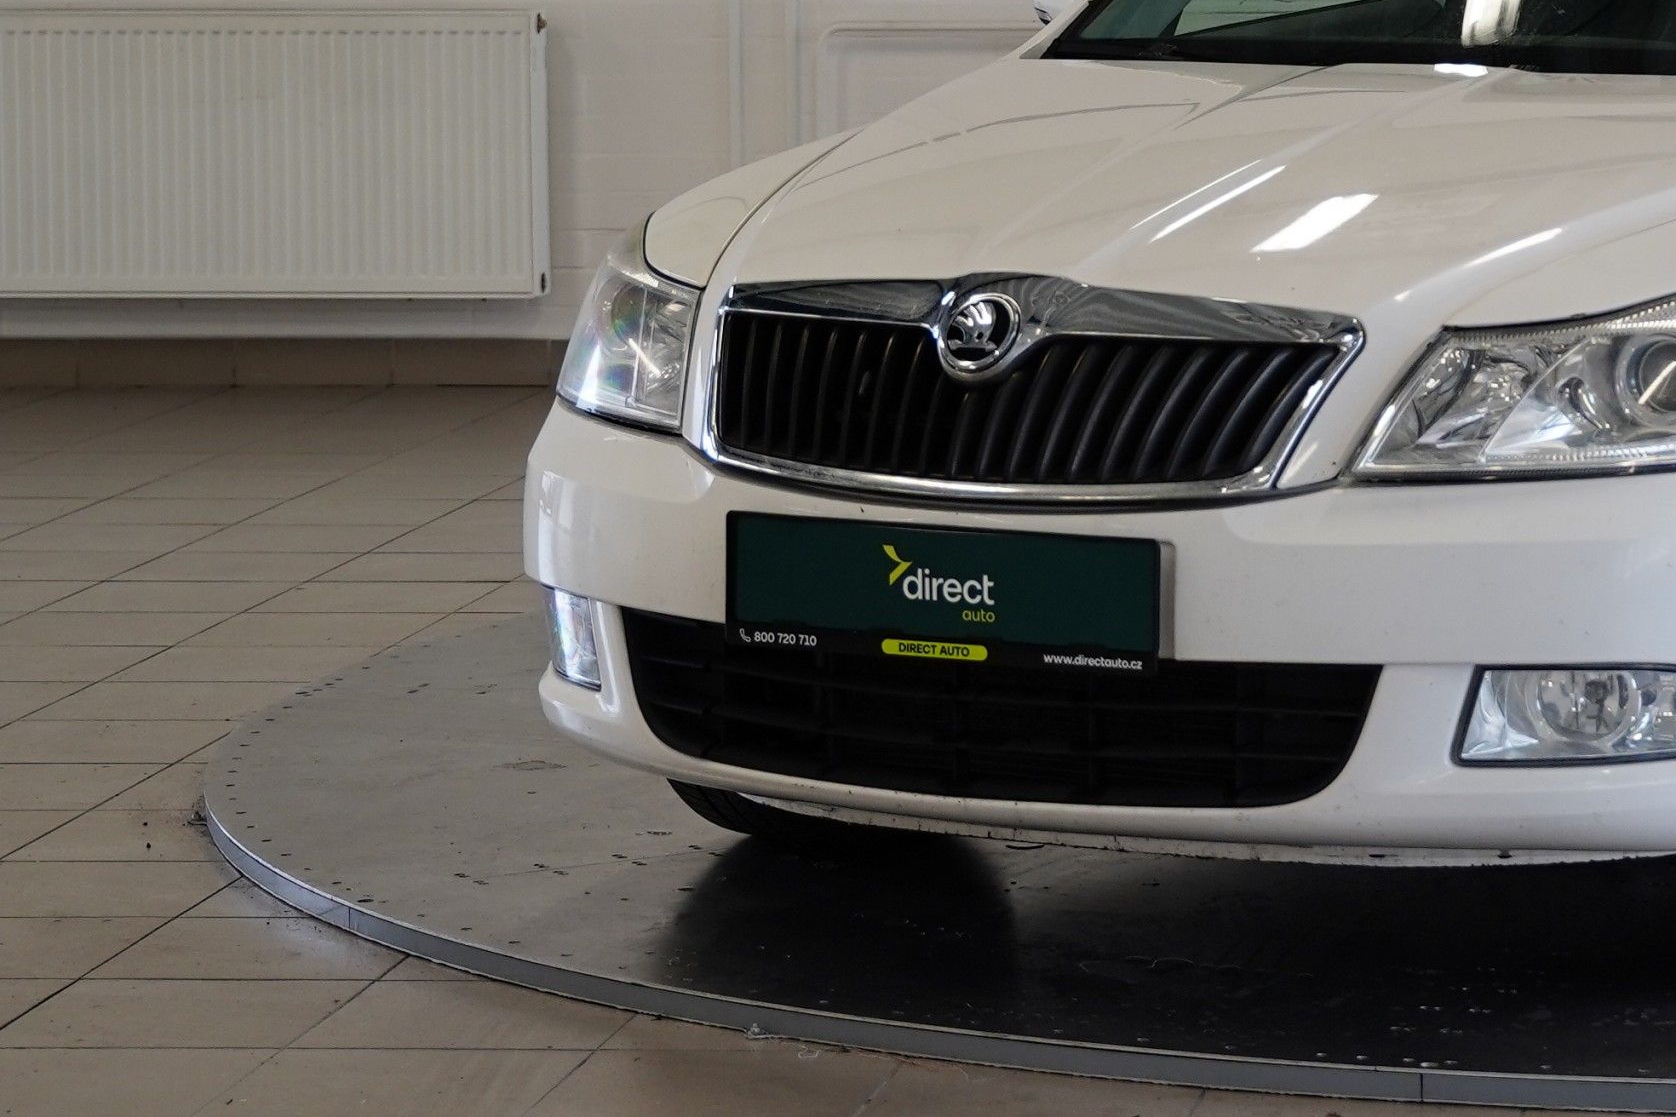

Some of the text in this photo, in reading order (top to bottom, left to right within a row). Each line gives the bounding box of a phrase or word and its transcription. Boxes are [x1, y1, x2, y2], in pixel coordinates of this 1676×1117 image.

[903, 568, 995, 605] direct
[962, 609, 995, 623] auto
[754, 631, 818, 646] 800 720 710
[898, 643, 970, 657] DIRECT AUTO
[1043, 654, 1143, 669] www.directauto.cz
